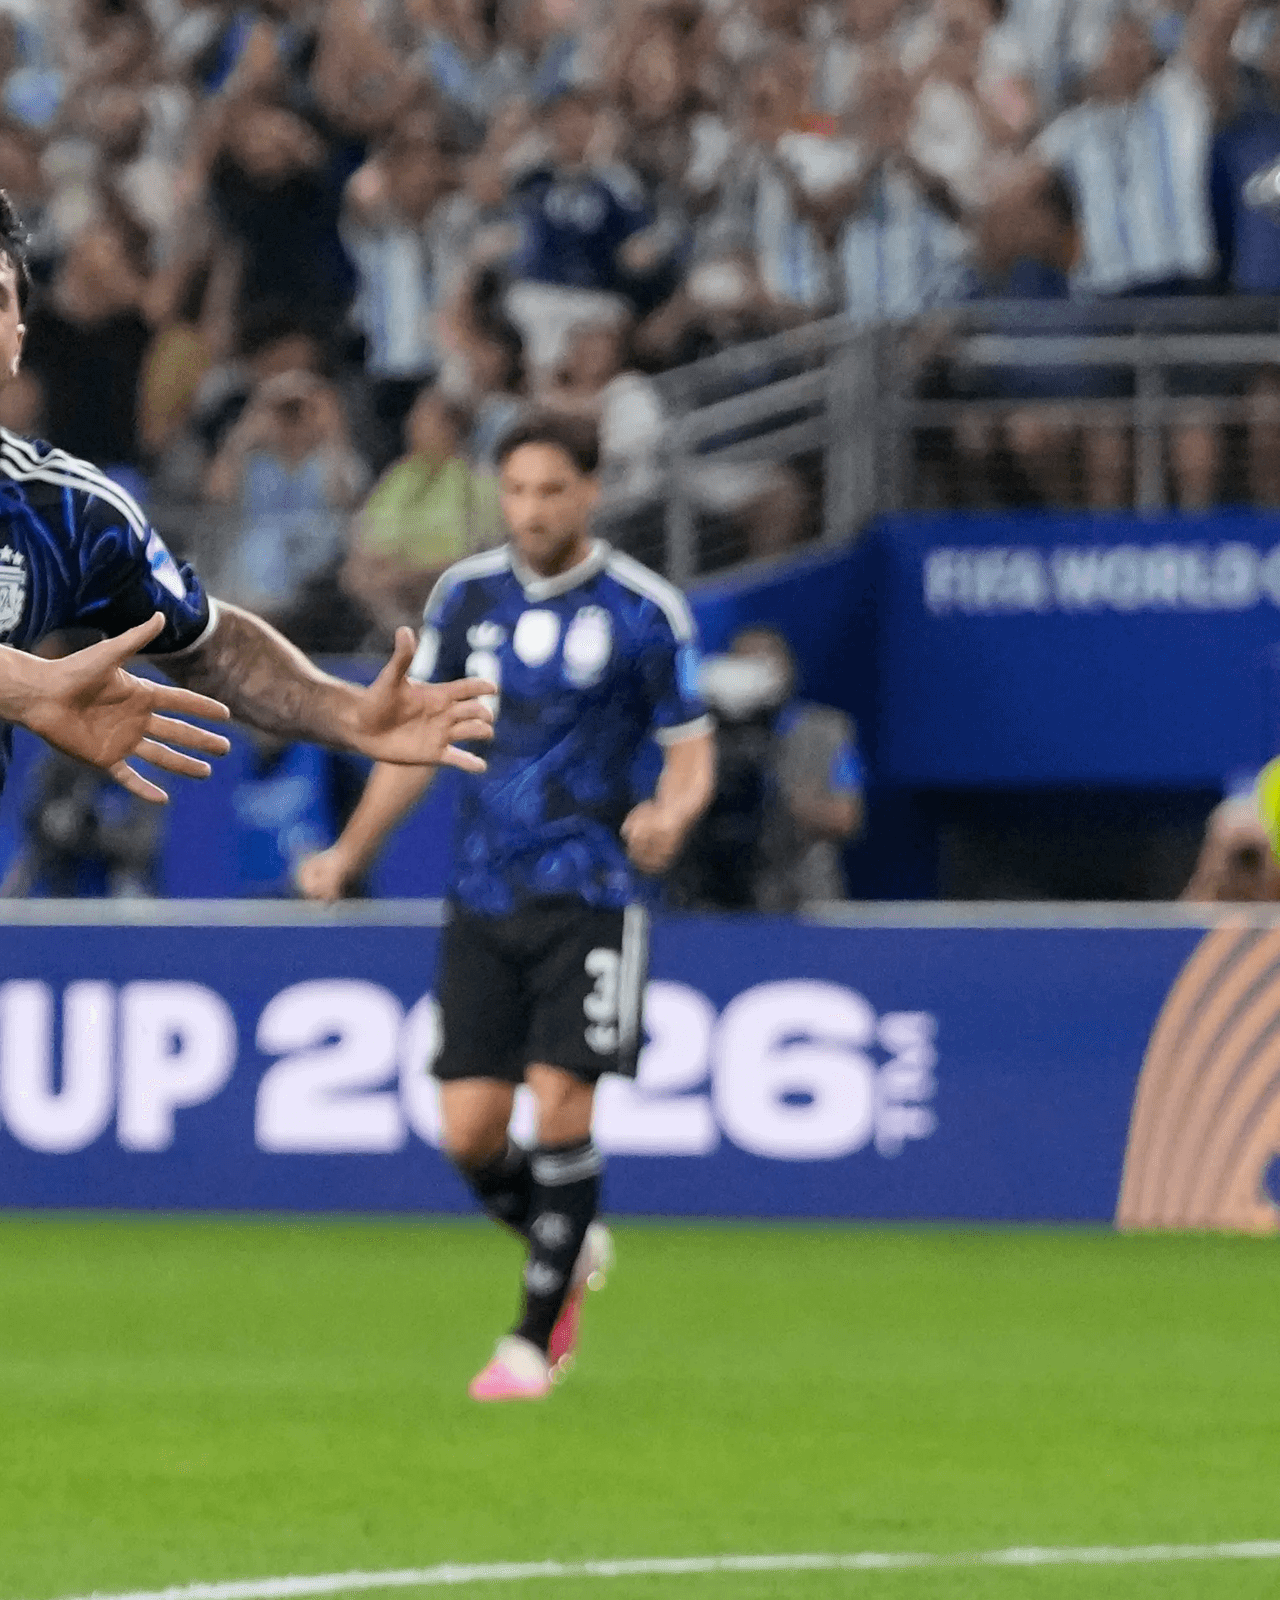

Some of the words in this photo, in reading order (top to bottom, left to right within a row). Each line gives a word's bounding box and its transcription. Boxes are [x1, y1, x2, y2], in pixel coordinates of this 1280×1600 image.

[924, 547, 1048, 615] FIFA
[1052, 541, 1258, 613] WORLD
[583, 946, 619, 1023] 3
